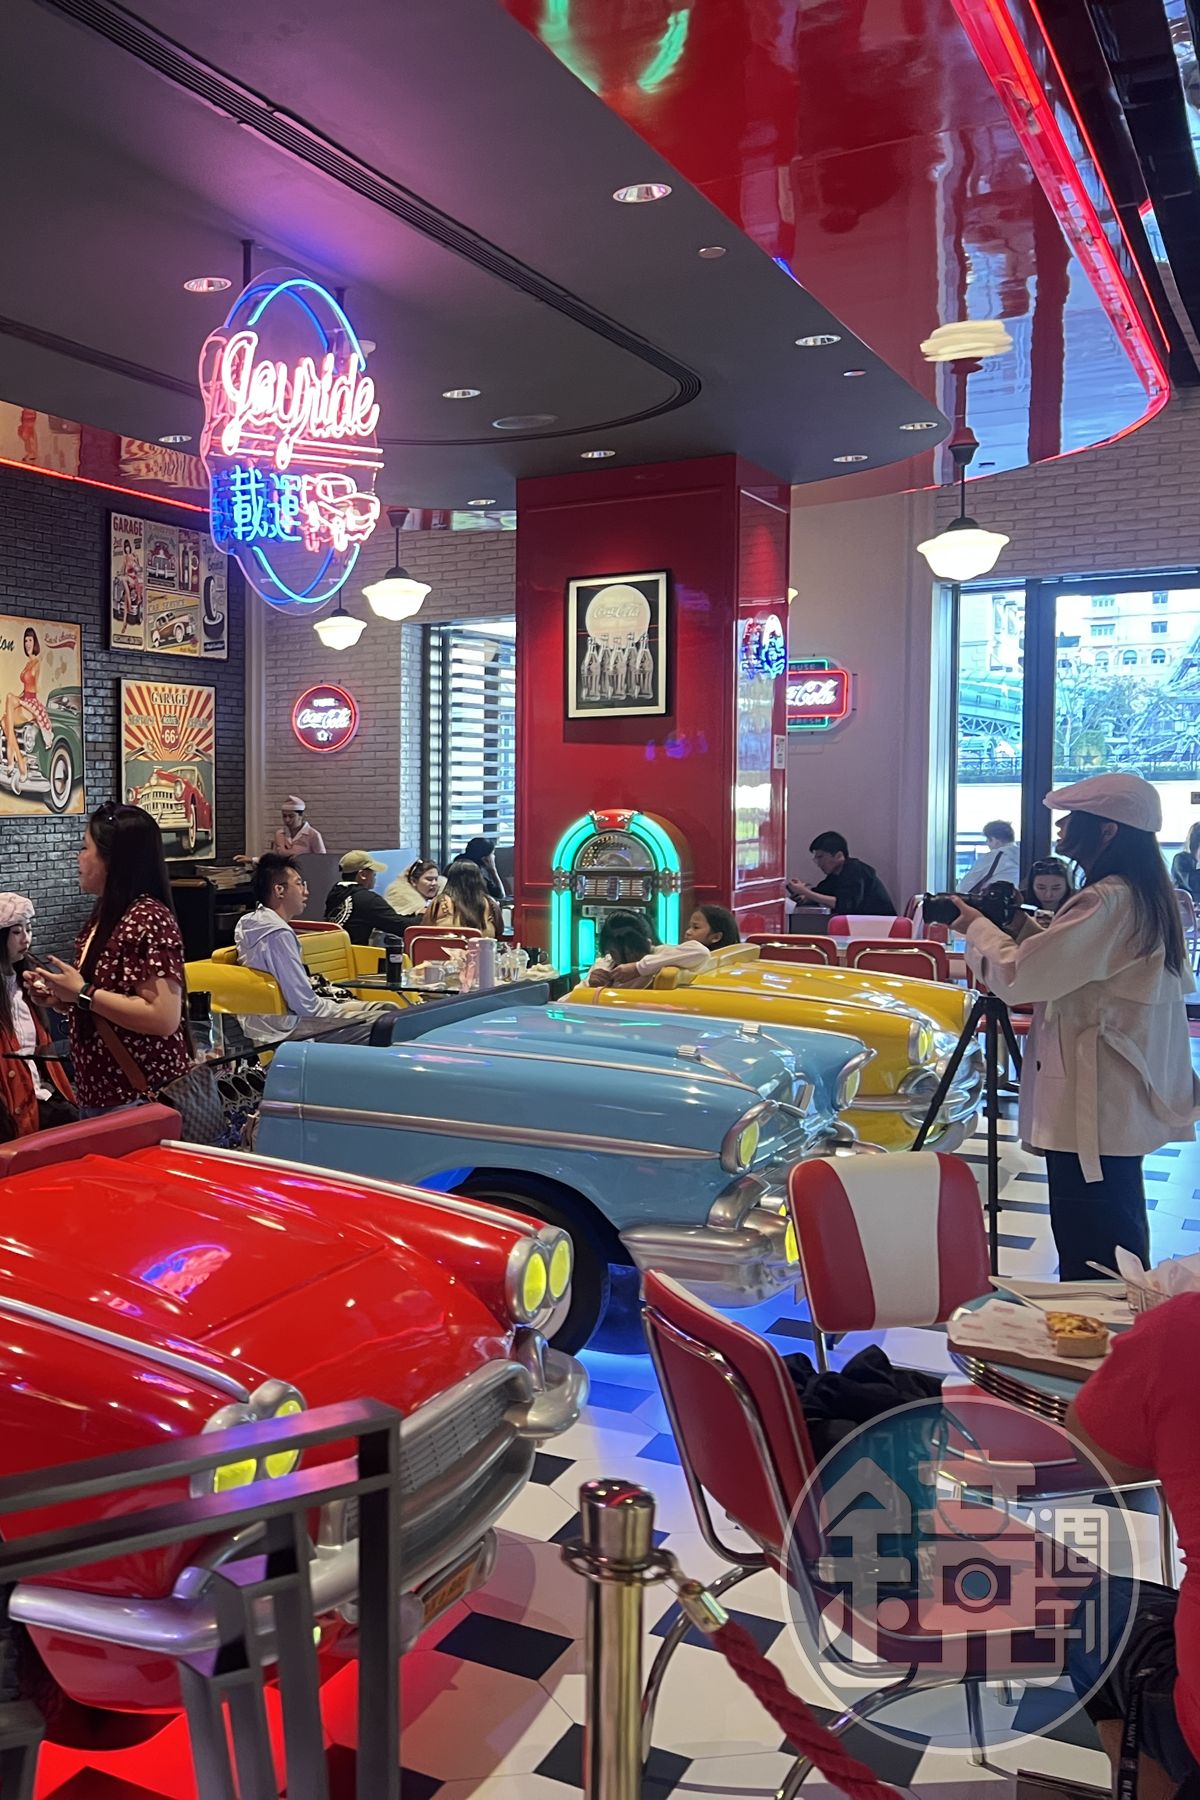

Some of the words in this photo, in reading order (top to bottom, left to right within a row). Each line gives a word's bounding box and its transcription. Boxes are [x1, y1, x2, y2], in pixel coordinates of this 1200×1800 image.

[221, 330, 380, 470] Joyride
[229, 464, 303, 542] 載運
[112, 515, 143, 537] GARAGE
[151, 691, 188, 707] GARAGE
[164, 729, 176, 744] 66
